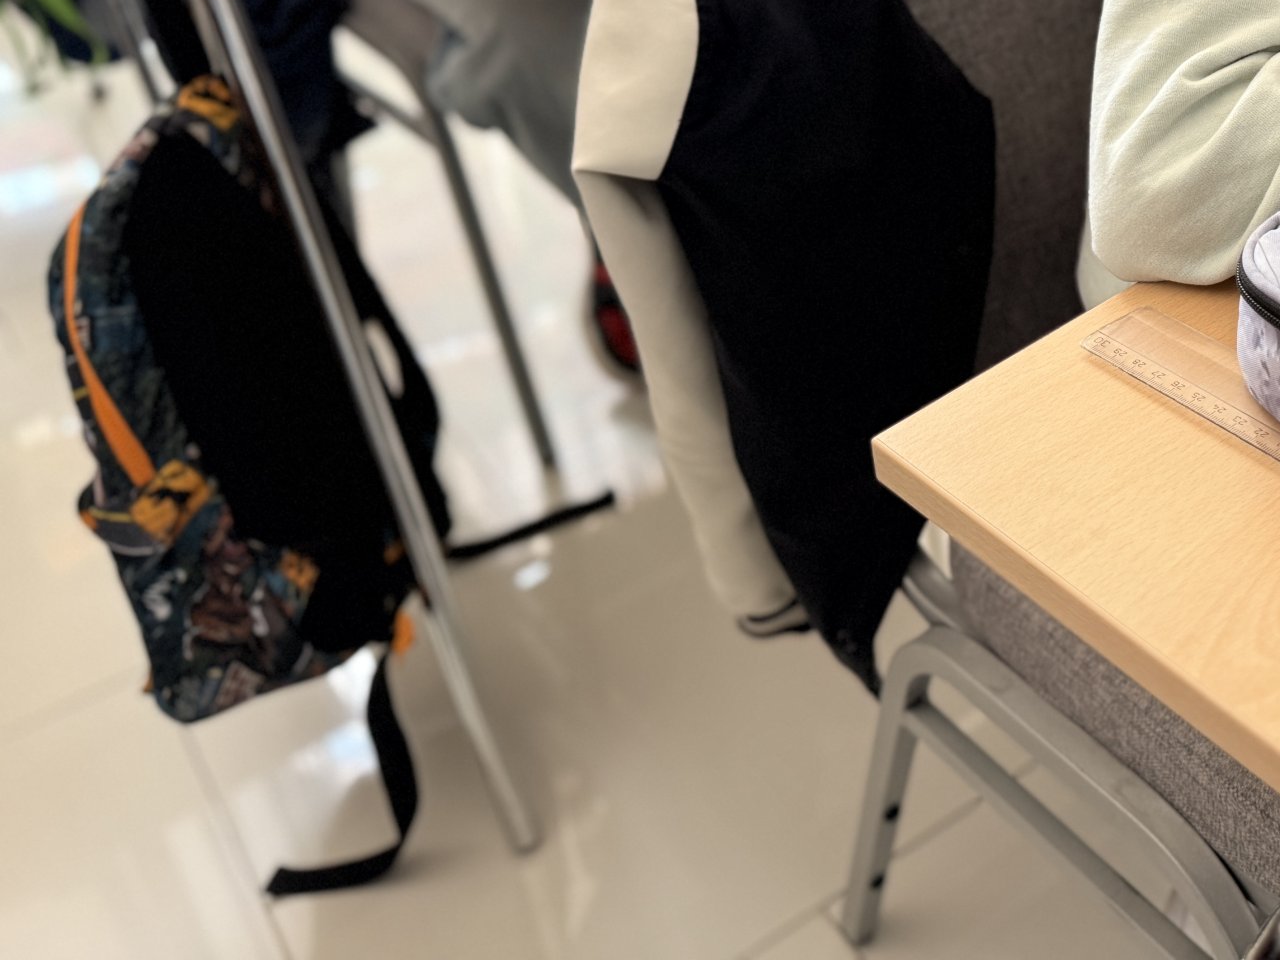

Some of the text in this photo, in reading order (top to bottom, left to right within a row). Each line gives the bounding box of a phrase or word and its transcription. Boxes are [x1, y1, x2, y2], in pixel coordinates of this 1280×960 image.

[1092, 336, 1111, 347] 30
[1113, 347, 1128, 357] 29
[1131, 358, 1147, 368] 28
[1150, 370, 1167, 380] 27
[1170, 380, 1187, 391] 26
[1191, 392, 1207, 403] 25
[1213, 403, 1228, 414] 24
[1232, 415, 1249, 426] 23
[1253, 427, 1270, 438] 22
